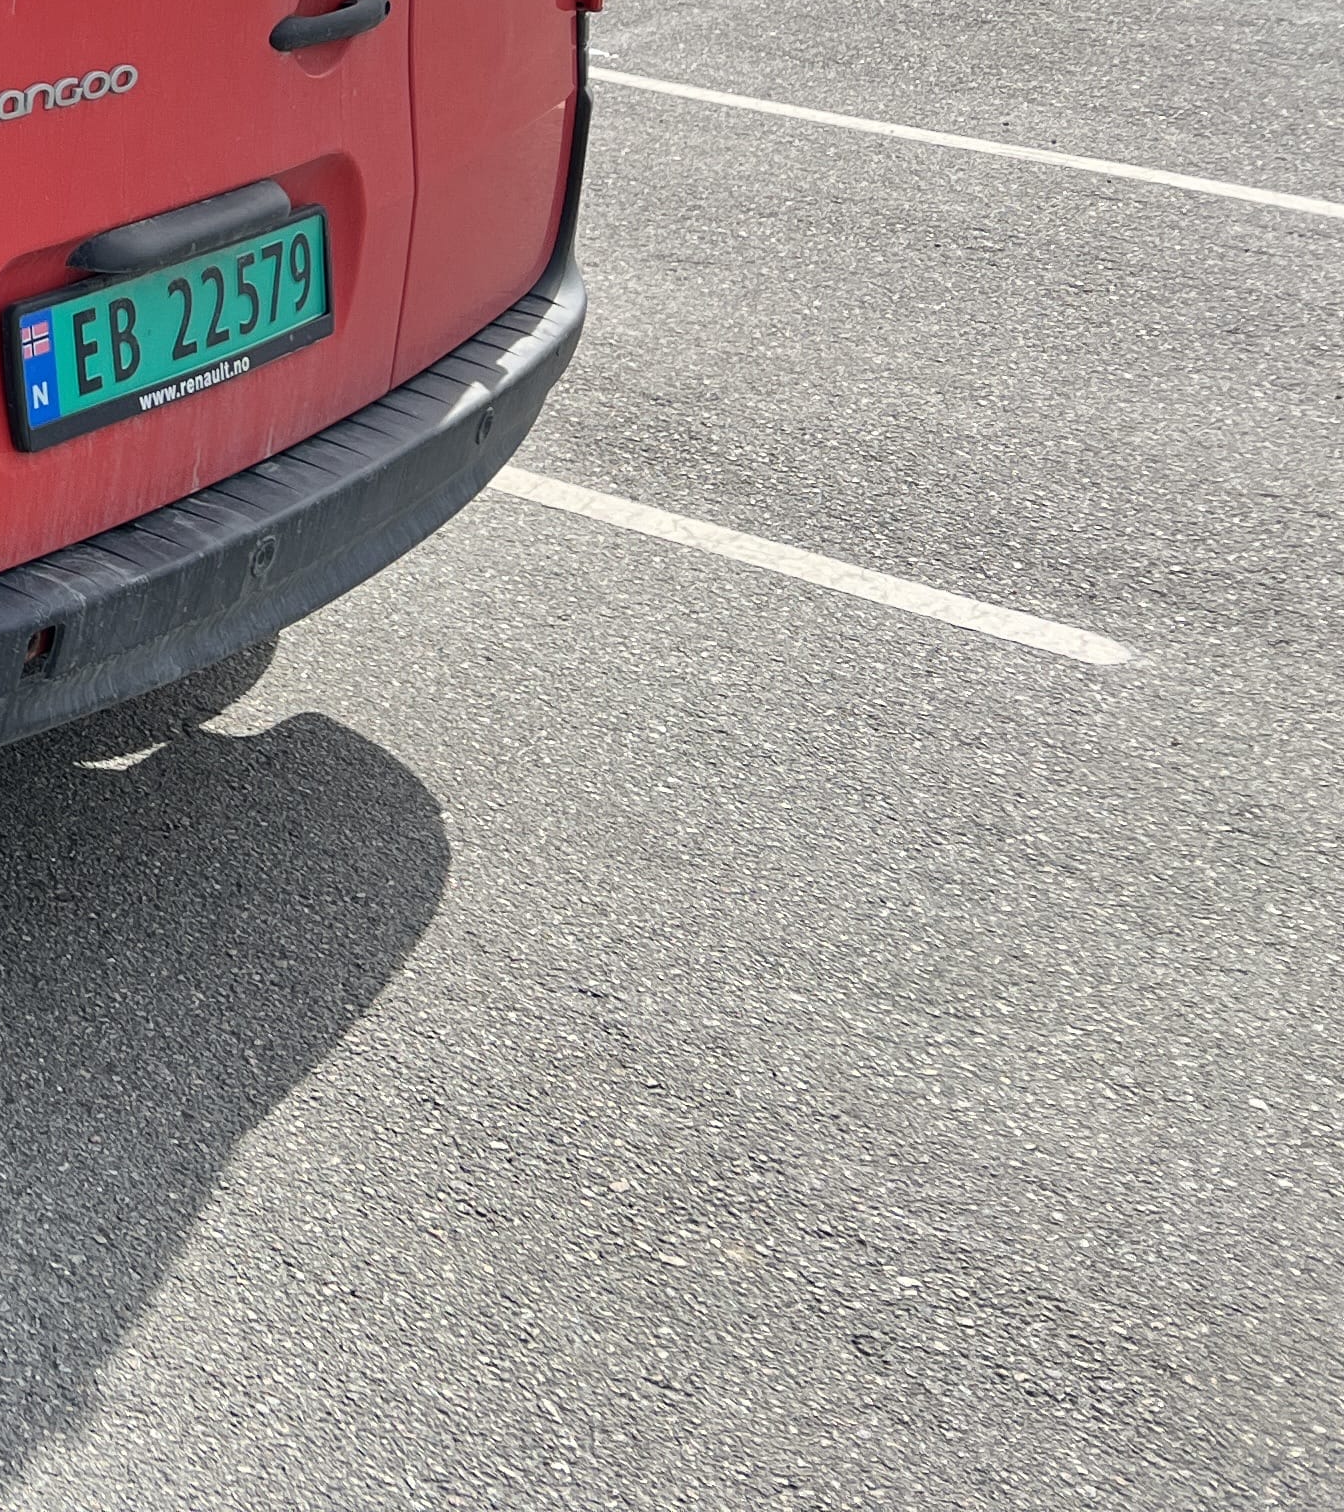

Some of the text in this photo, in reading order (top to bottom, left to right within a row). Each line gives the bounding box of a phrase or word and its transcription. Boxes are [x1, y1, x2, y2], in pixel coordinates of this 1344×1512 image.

[72, 232, 311, 397] EB 22579
[31, 381, 49, 409] N
[139, 356, 251, 411] www.renault.no
